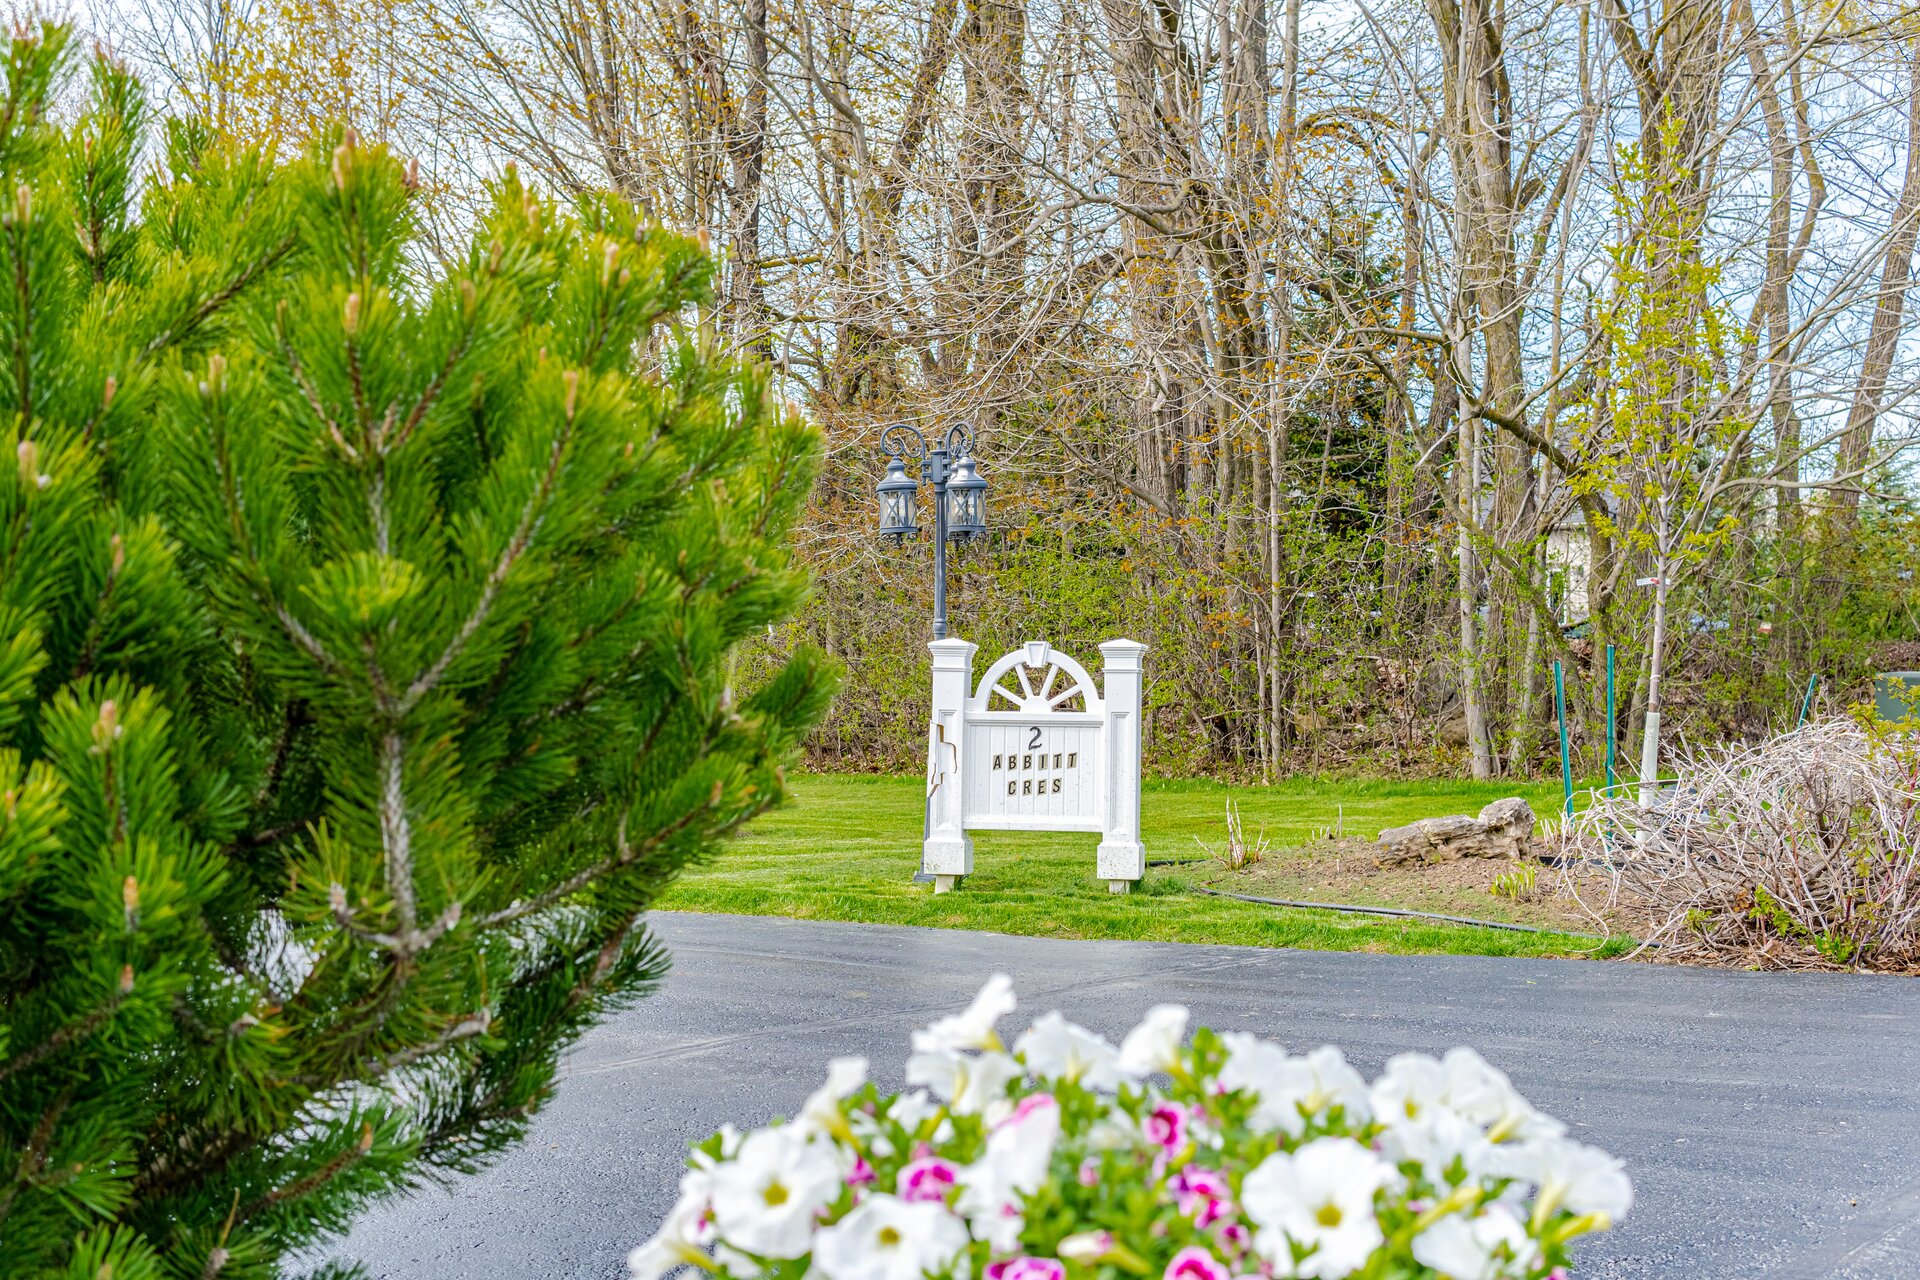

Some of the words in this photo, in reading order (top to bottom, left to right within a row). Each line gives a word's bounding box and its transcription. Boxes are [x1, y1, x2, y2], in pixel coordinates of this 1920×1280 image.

[1028, 726, 1042, 751] 2
[993, 752, 1077, 771] ABBITT
[1008, 779, 1061, 795] CRES
